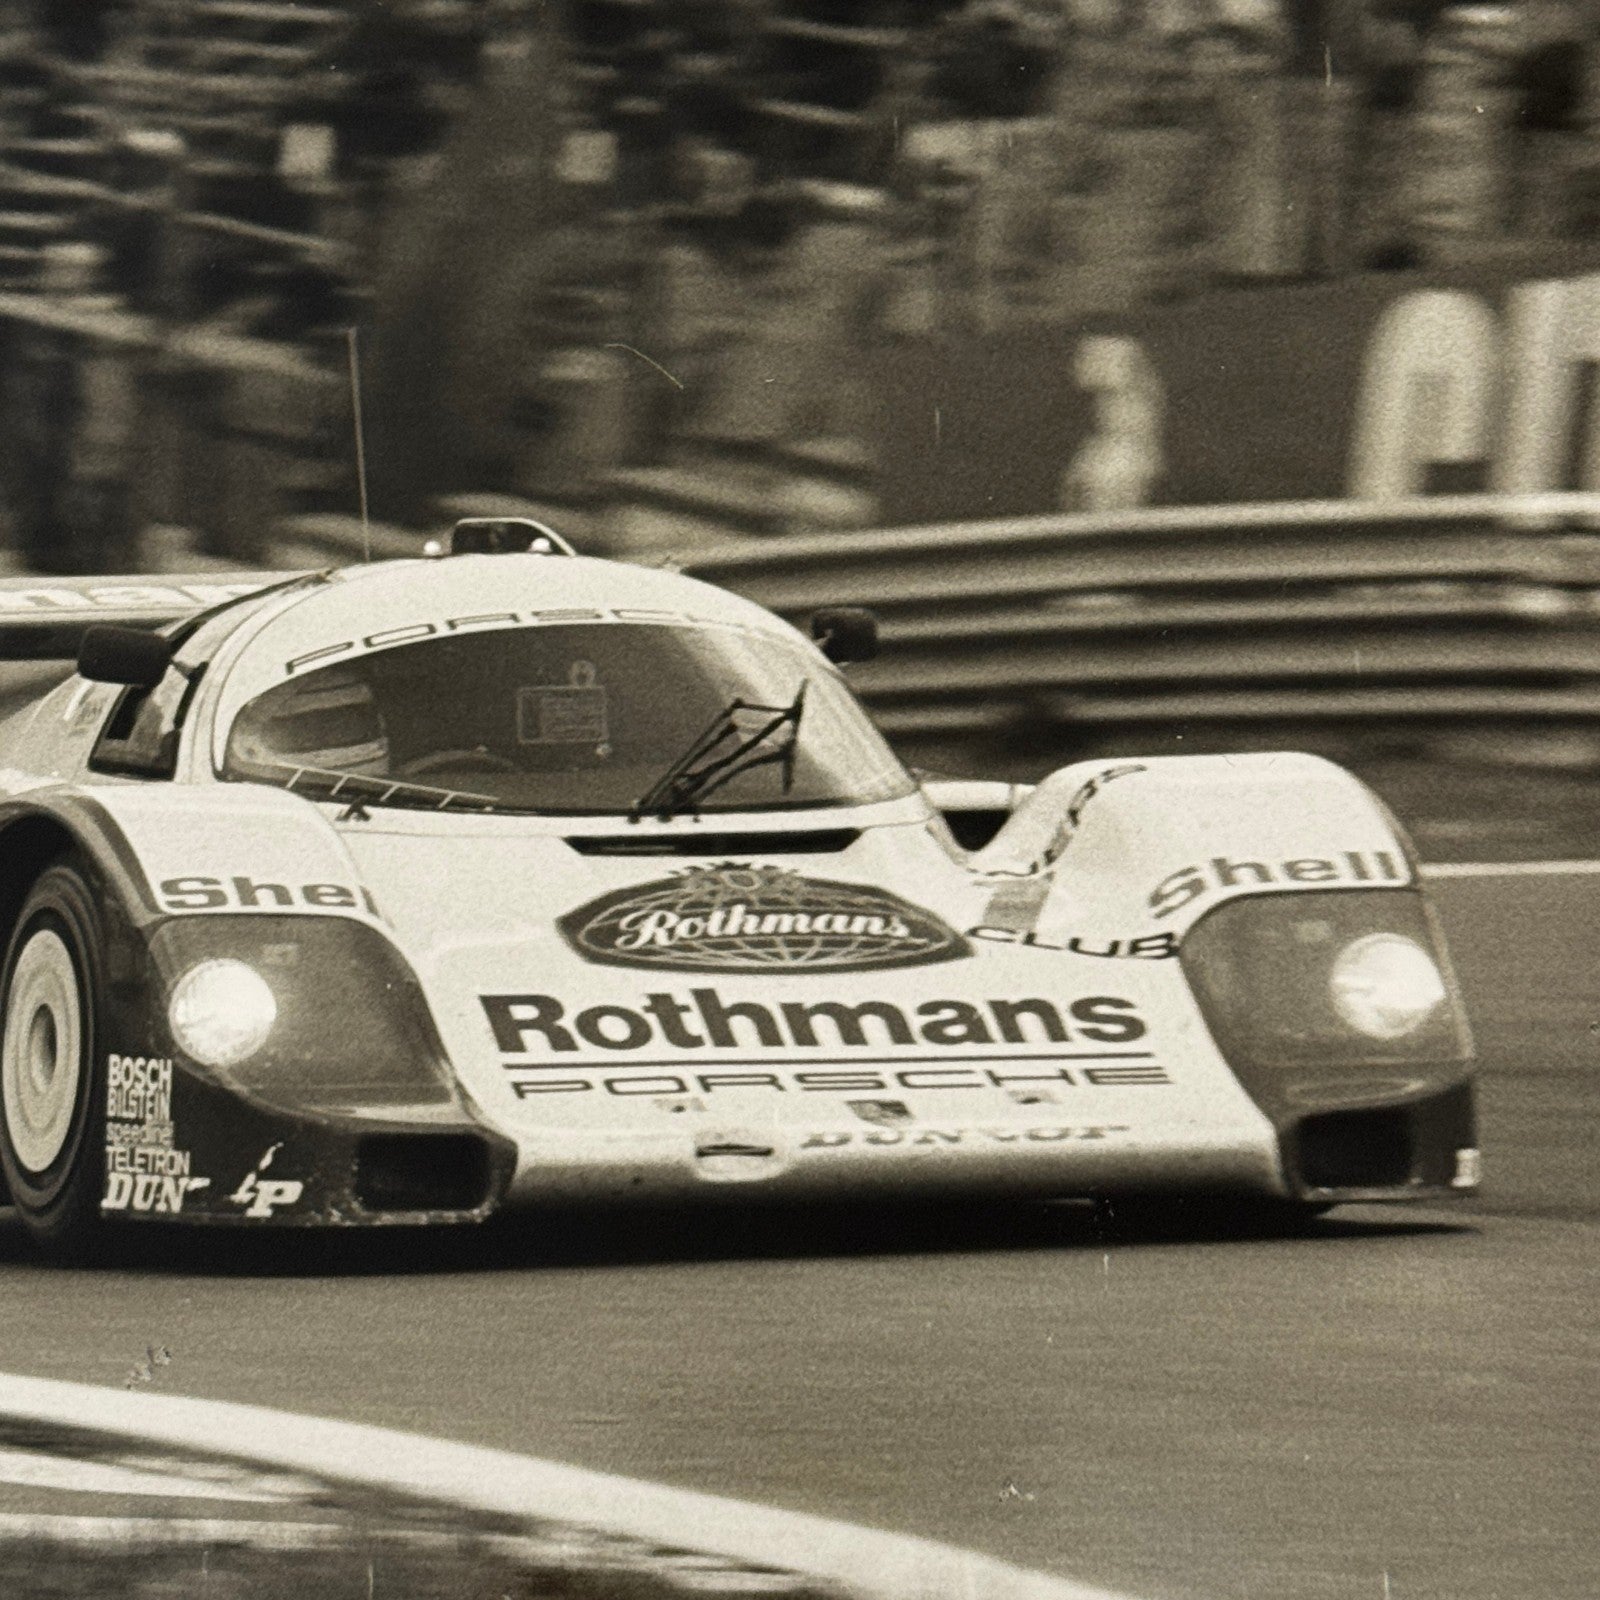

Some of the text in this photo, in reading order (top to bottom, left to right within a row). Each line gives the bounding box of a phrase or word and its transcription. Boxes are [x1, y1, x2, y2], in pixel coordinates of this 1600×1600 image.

[1147, 850, 1398, 919] Shell
[614, 904, 911, 950] Rothmans
[966, 930, 1180, 960] CLUB
[478, 988, 1148, 1053] Rothmans
[108, 1053, 173, 1090] BOSCH
[511, 1065, 1175, 1099] PORSCHE
[107, 1087, 172, 1121] BILSTEIN
[105, 1145, 191, 1176] TELETRON
